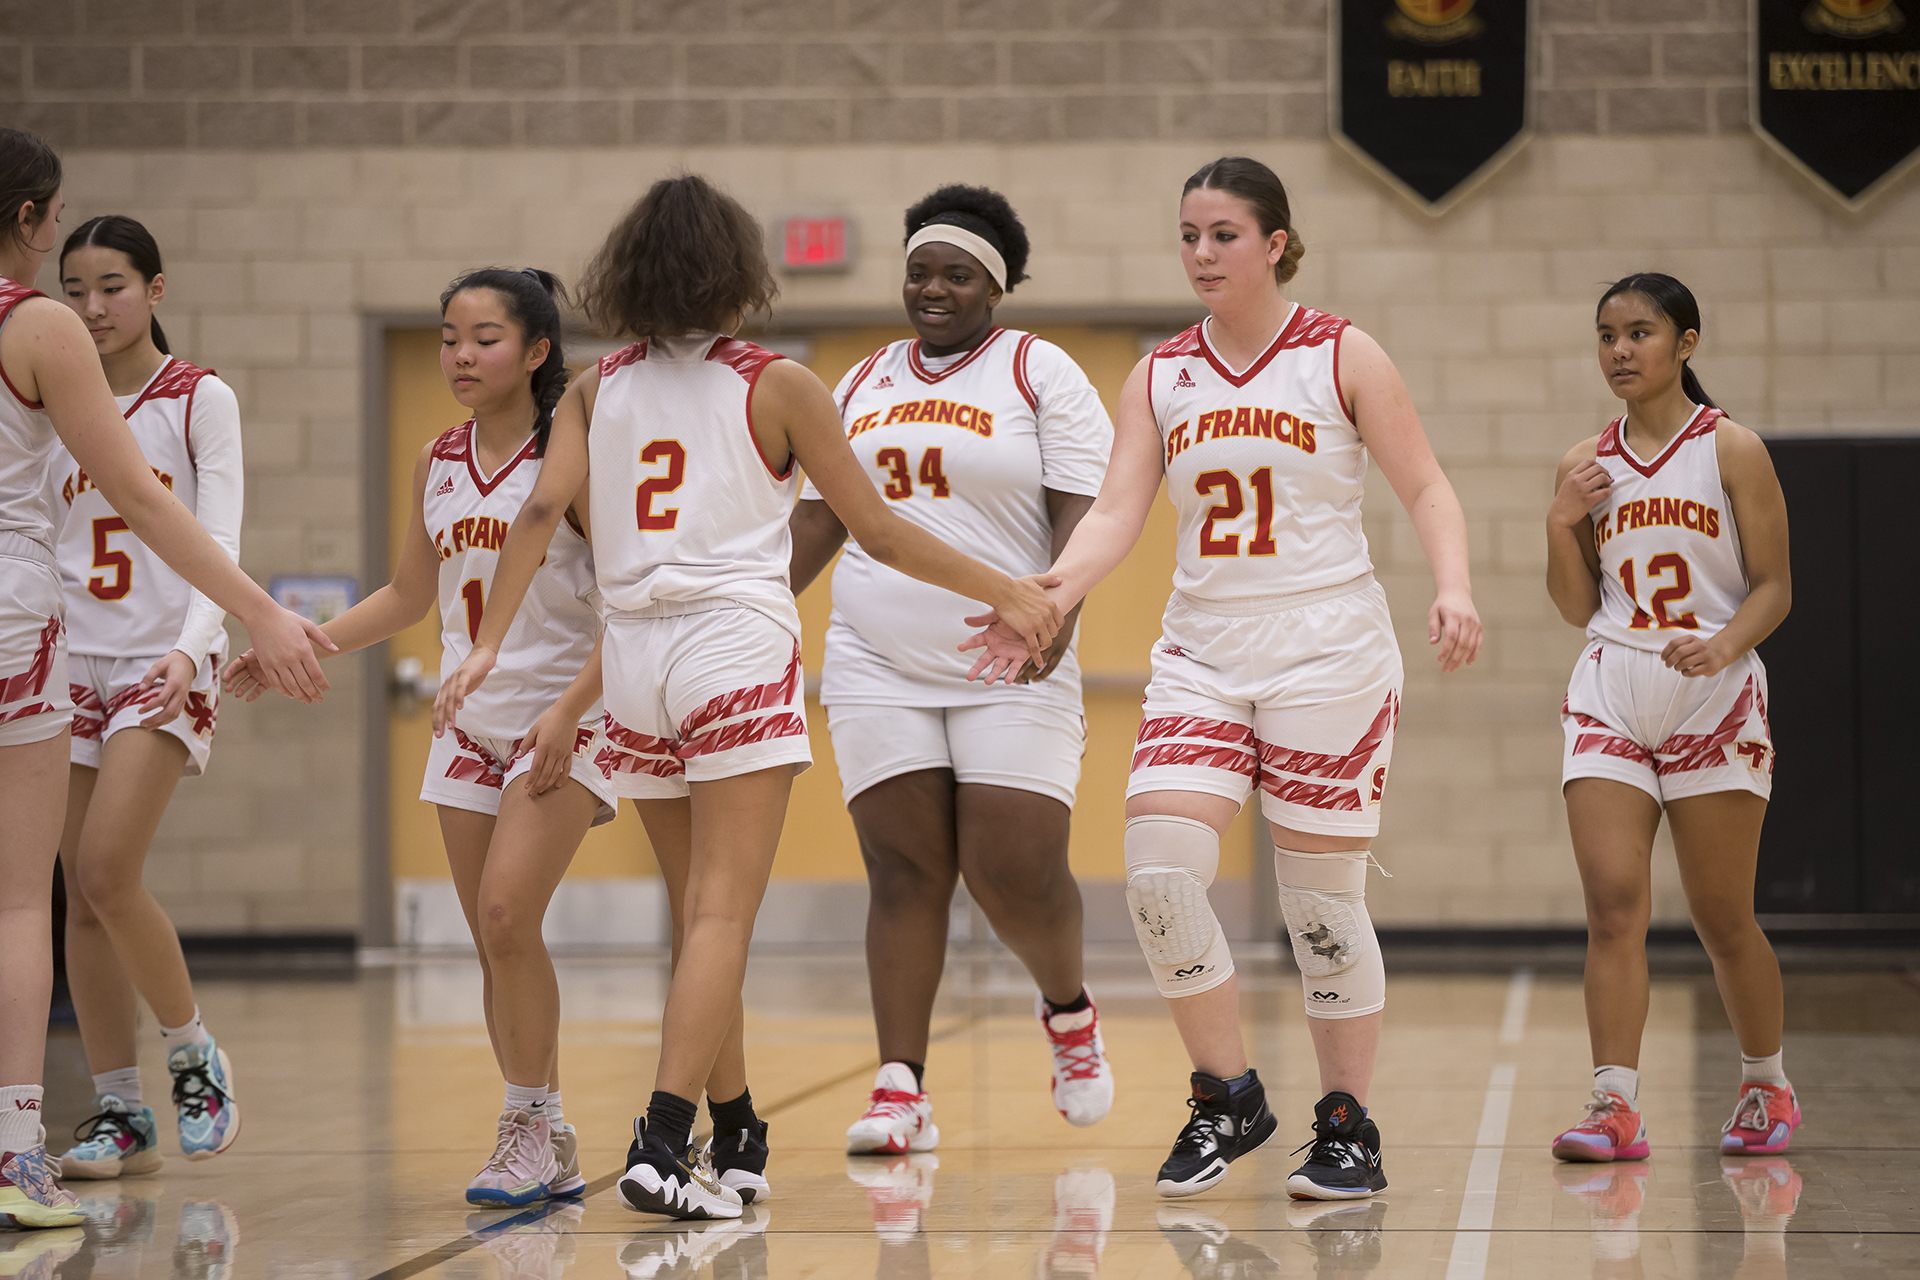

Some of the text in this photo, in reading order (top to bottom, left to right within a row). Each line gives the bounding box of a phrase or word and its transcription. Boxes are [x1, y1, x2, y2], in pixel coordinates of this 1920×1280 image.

[1388, 59, 1481, 97] FAITH
[1769, 52, 1920, 90] EXCELLENC
[848, 399, 994, 441] ST. FRANCIS
[1167, 407, 1317, 467] ST. FRANCIS
[636, 439, 687, 532] 2
[875, 447, 951, 501] 34
[1194, 466, 1277, 558] 21
[1616, 496, 1719, 539] FRANCIS
[87, 515, 133, 601] 5
[1619, 552, 1700, 630] 12
